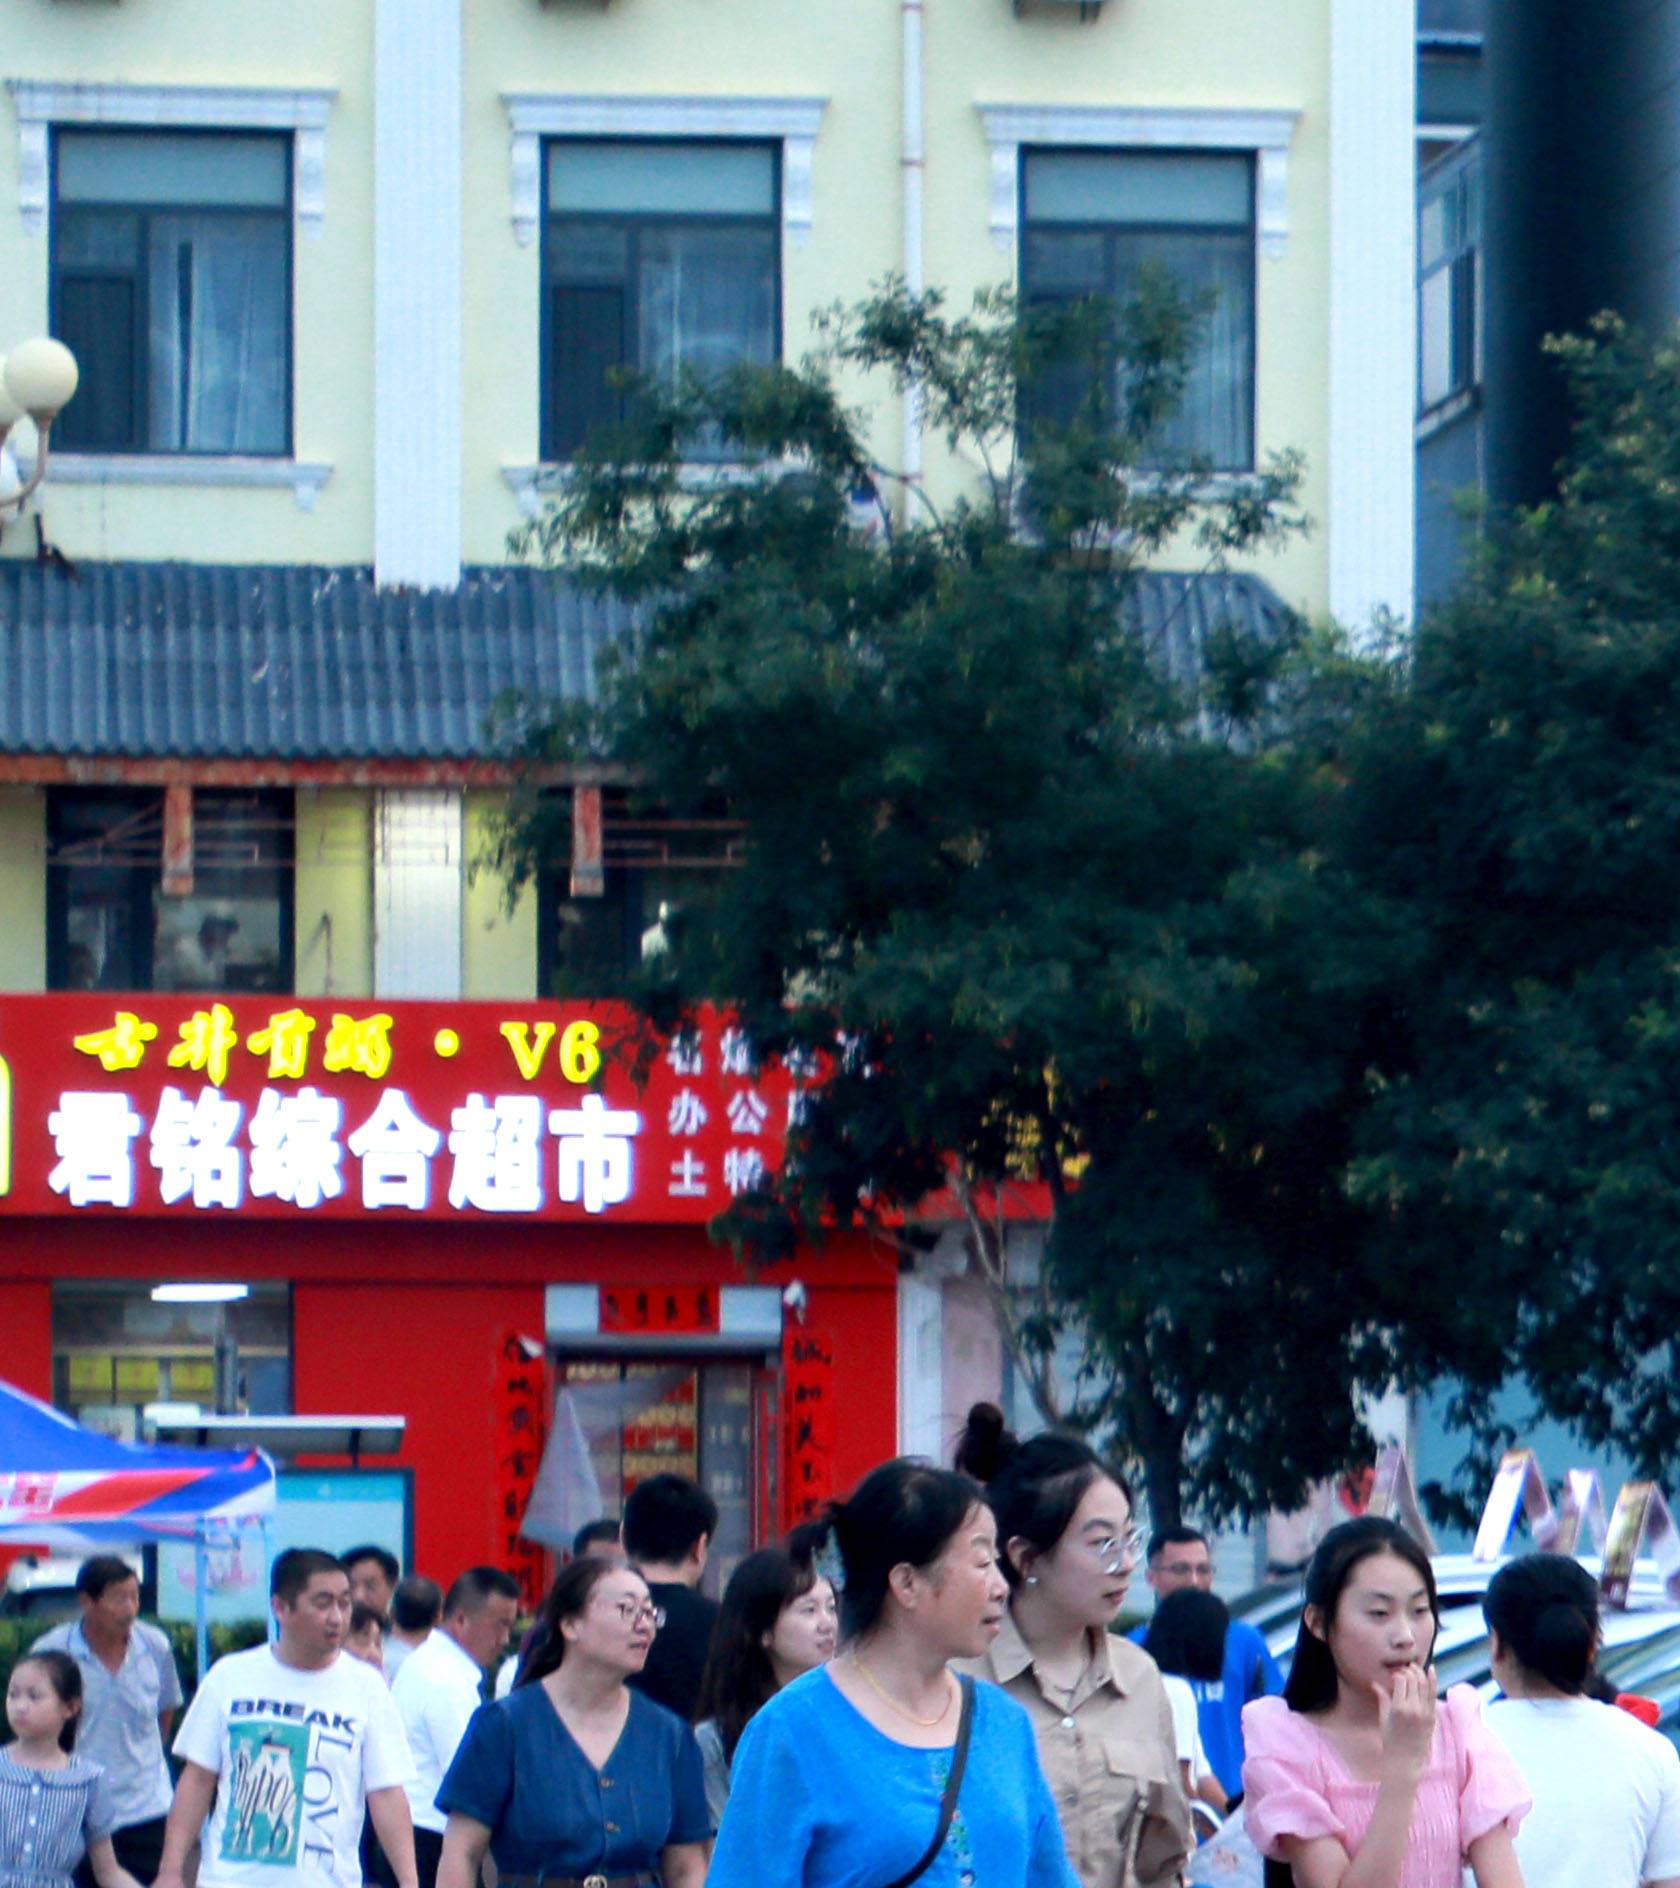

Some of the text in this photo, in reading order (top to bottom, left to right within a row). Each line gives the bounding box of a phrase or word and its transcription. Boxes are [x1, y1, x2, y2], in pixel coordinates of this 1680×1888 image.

[48, 1087, 642, 1213] 君铭综合超市
[231, 1699, 357, 1736] BREAK
